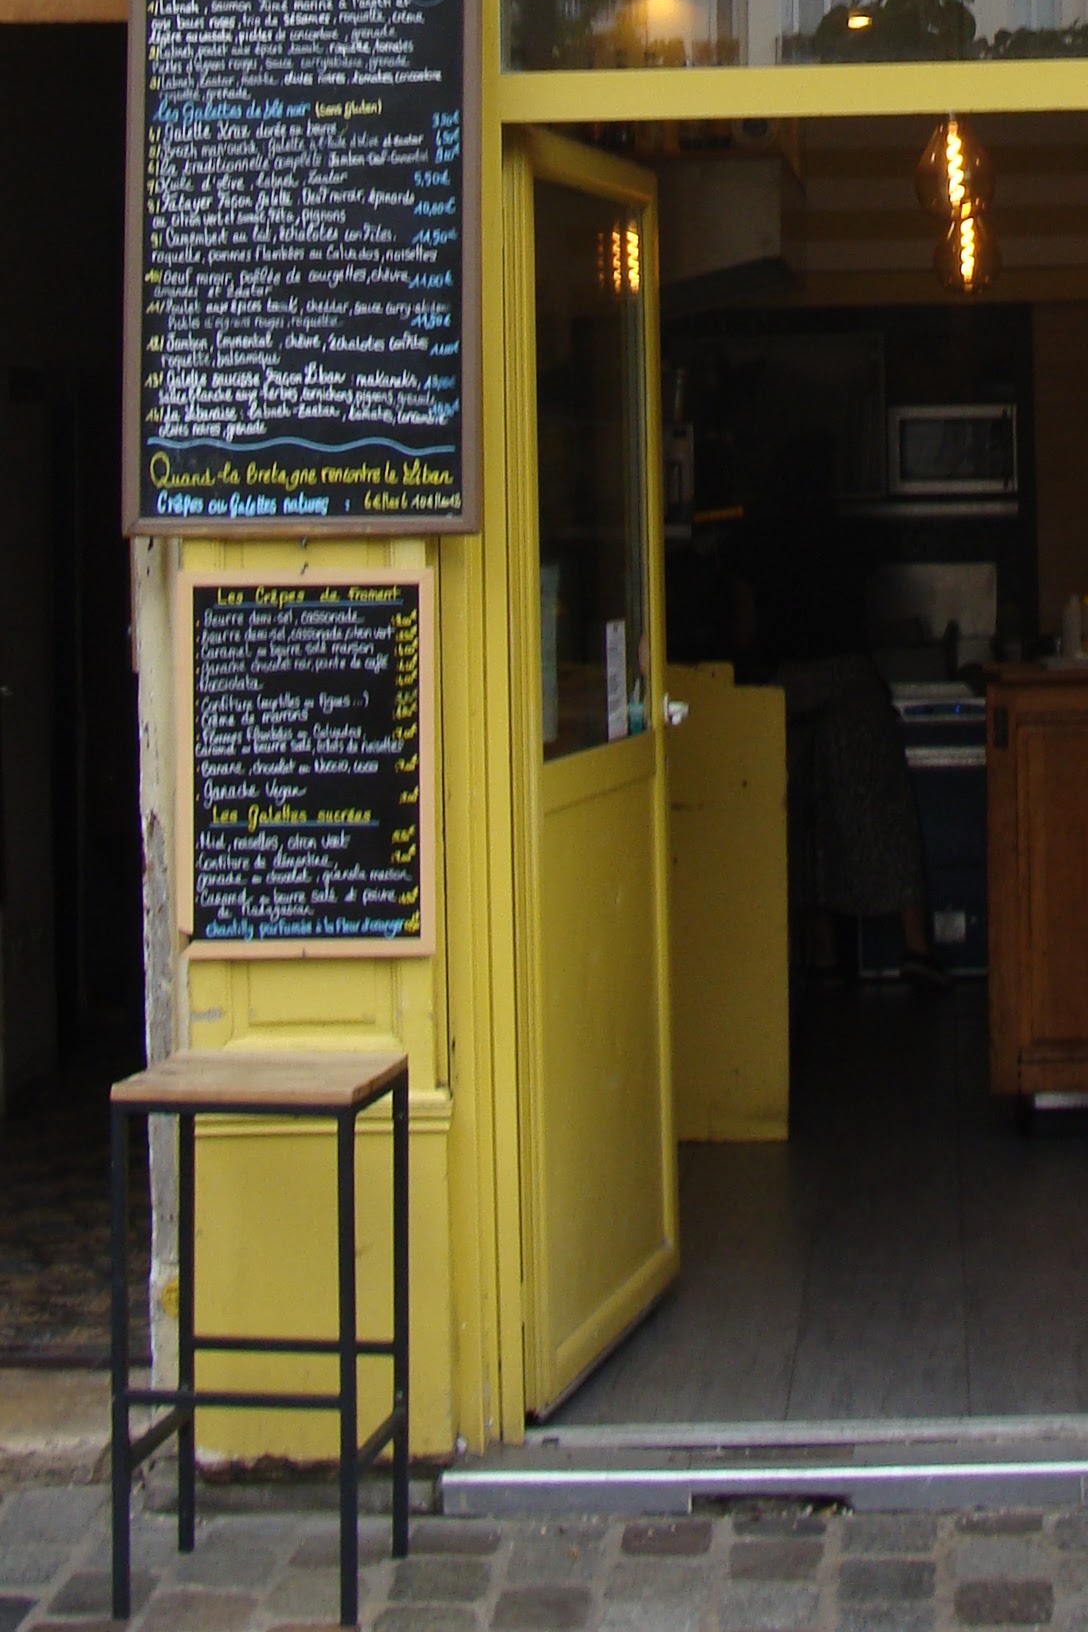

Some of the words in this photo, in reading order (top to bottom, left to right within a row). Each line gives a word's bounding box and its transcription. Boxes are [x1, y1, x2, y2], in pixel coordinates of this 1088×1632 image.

[211, 0, 251, 13] saumon
[286, 101, 311, 117] noir
[171, 211, 201, 228] citron
[302, 207, 346, 229] pignons
[166, 226, 229, 249] Camembert
[208, 248, 251, 267] pommes
[386, 243, 438, 263] noisettes
[217, 348, 281, 370] balsamique
[150, 450, 216, 489] Quand
[246, 460, 317, 492] Bretagne
[321, 462, 380, 485] rencontre
[402, 457, 454, 486] Liban
[157, 489, 204, 517] Crêpes
[208, 497, 228, 515] ou
[230, 491, 277, 518] Galettes
[283, 491, 329, 516] natures
[217, 586, 244, 606] Les
[255, 584, 305, 609] Crêpes
[320, 586, 340, 603] de
[212, 805, 238, 824] Les
